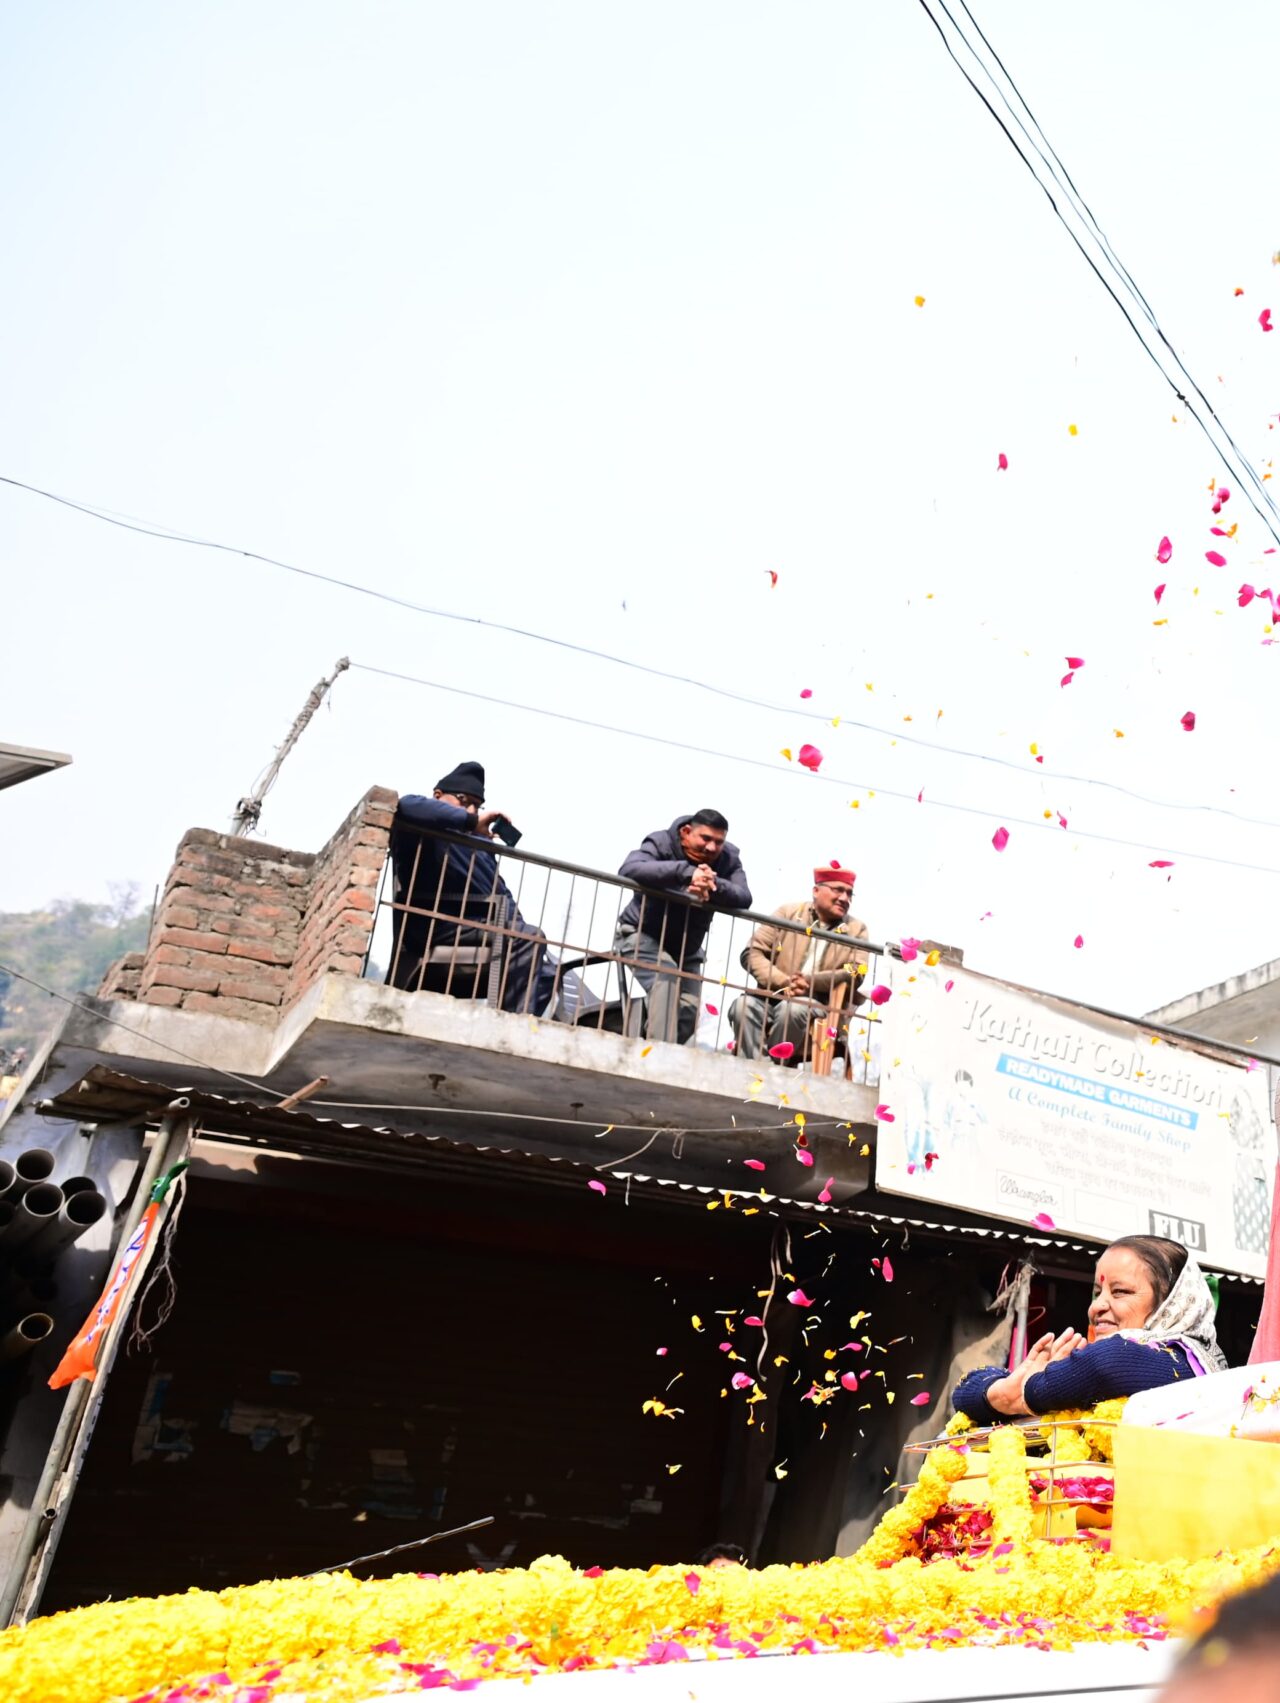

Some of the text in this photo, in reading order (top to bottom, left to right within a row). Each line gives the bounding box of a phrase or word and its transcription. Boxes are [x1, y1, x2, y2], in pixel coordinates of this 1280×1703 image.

[962, 999, 1225, 1109] Kathait Collection
[1006, 1058, 1193, 1126] READYMADE GARMENTS
[1026, 1089, 1096, 1124] Complete
[1101, 1111, 1153, 1140] Family
[1157, 1128, 1192, 1153] Shop
